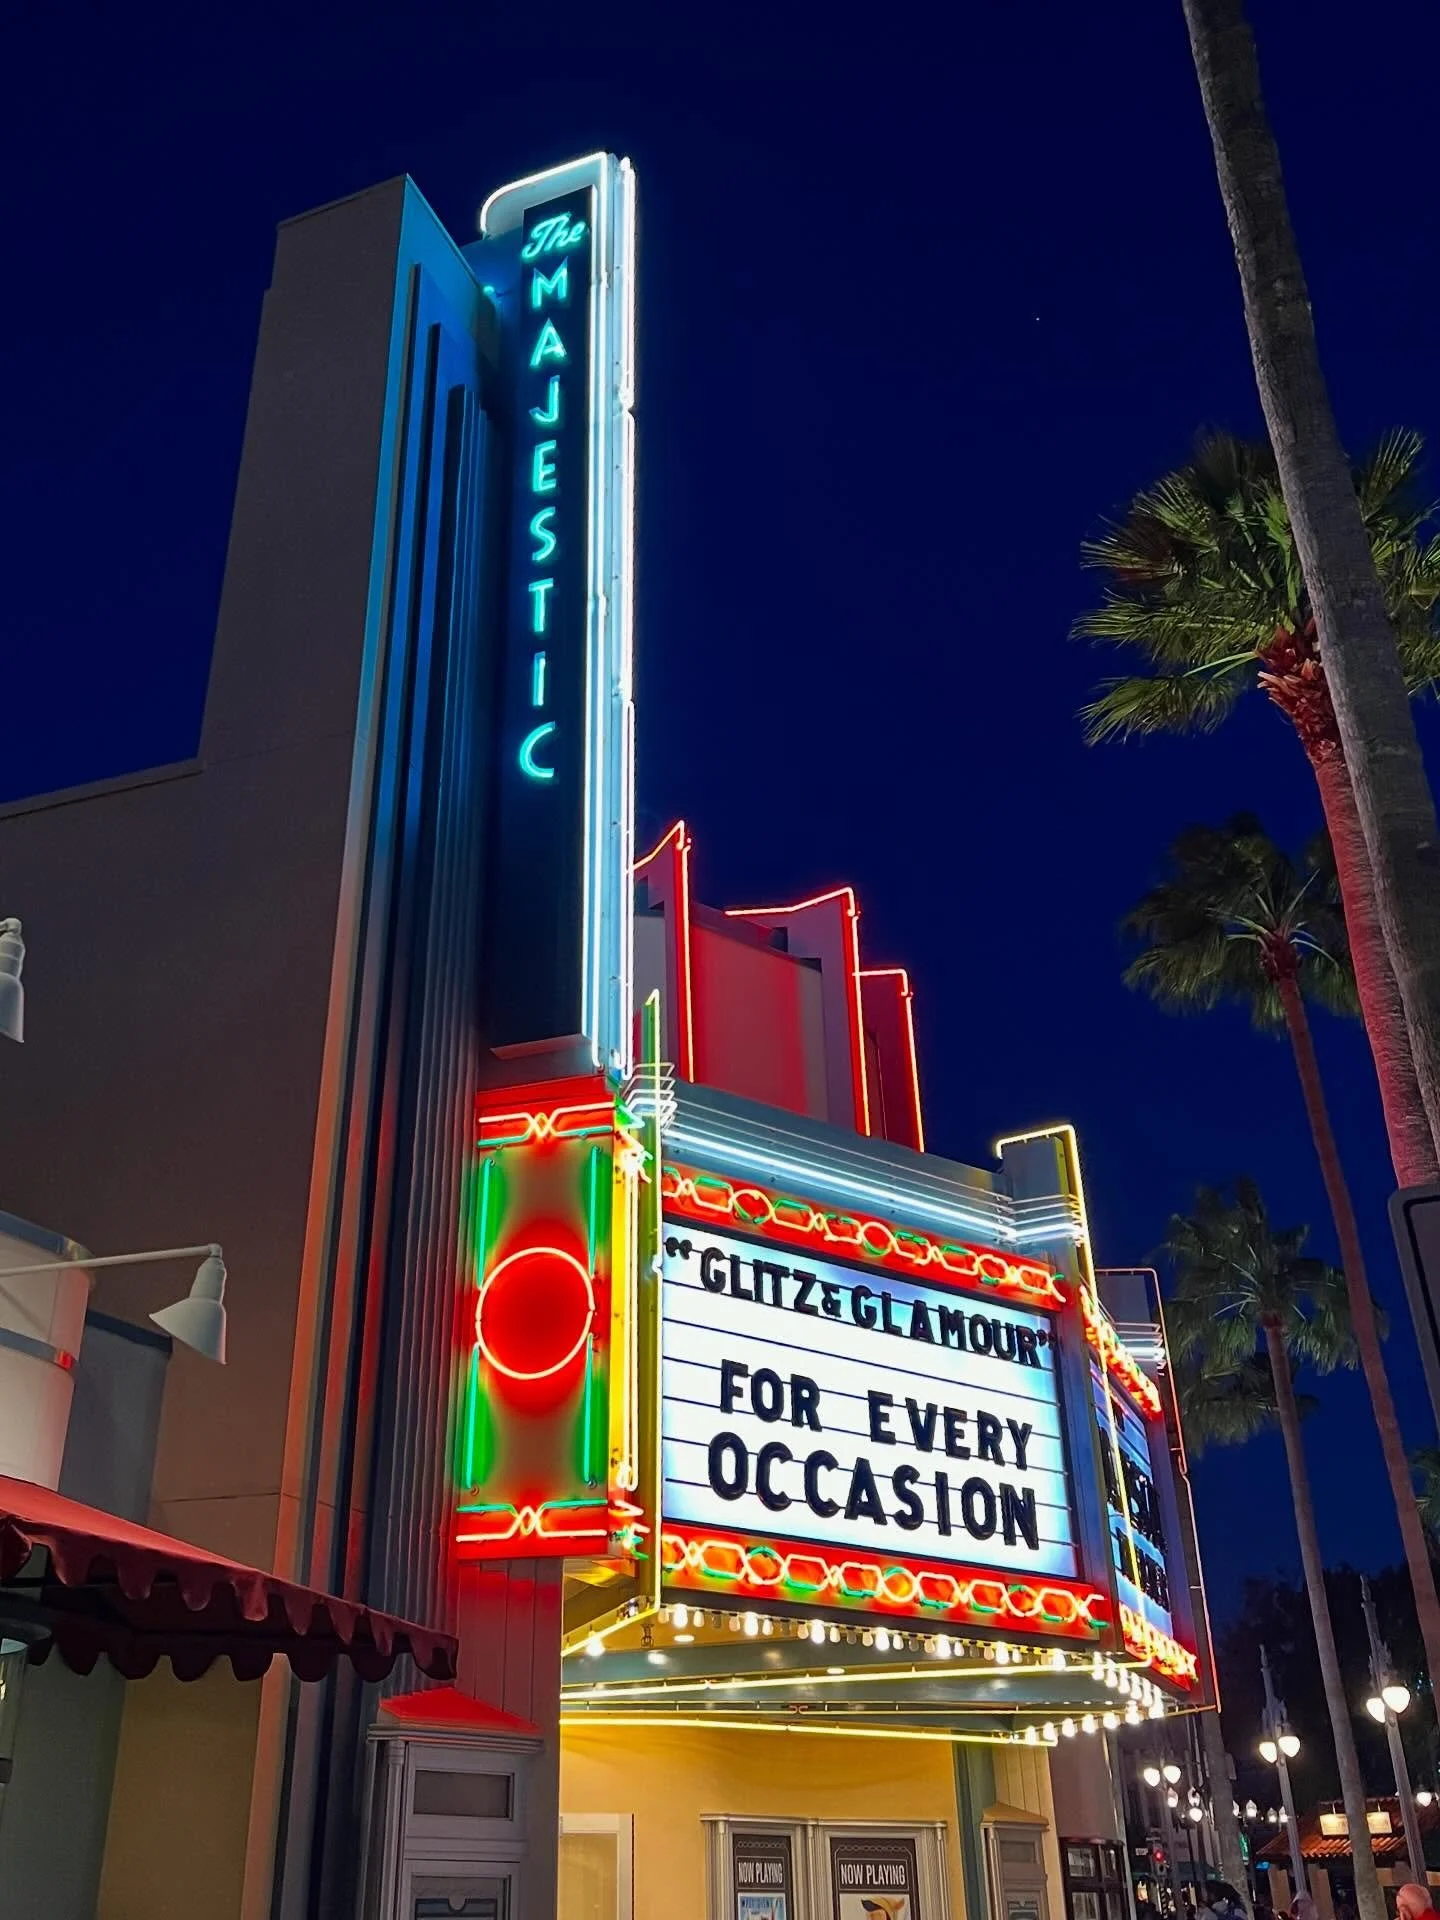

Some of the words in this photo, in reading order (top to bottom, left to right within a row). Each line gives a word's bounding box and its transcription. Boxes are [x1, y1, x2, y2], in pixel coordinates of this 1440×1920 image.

[521, 211, 587, 259] The
[519, 256, 568, 779] MAJESTIC
[720, 1359, 822, 1433] FOR
[867, 1389, 1033, 1471] EVERY
[708, 1431, 1040, 1551] OCCASION
[738, 1862, 754, 1883] NOW
[755, 1862, 783, 1884] PLAYING
[840, 1864, 863, 1886] NOW
[866, 1864, 906, 1886] PLAYING
